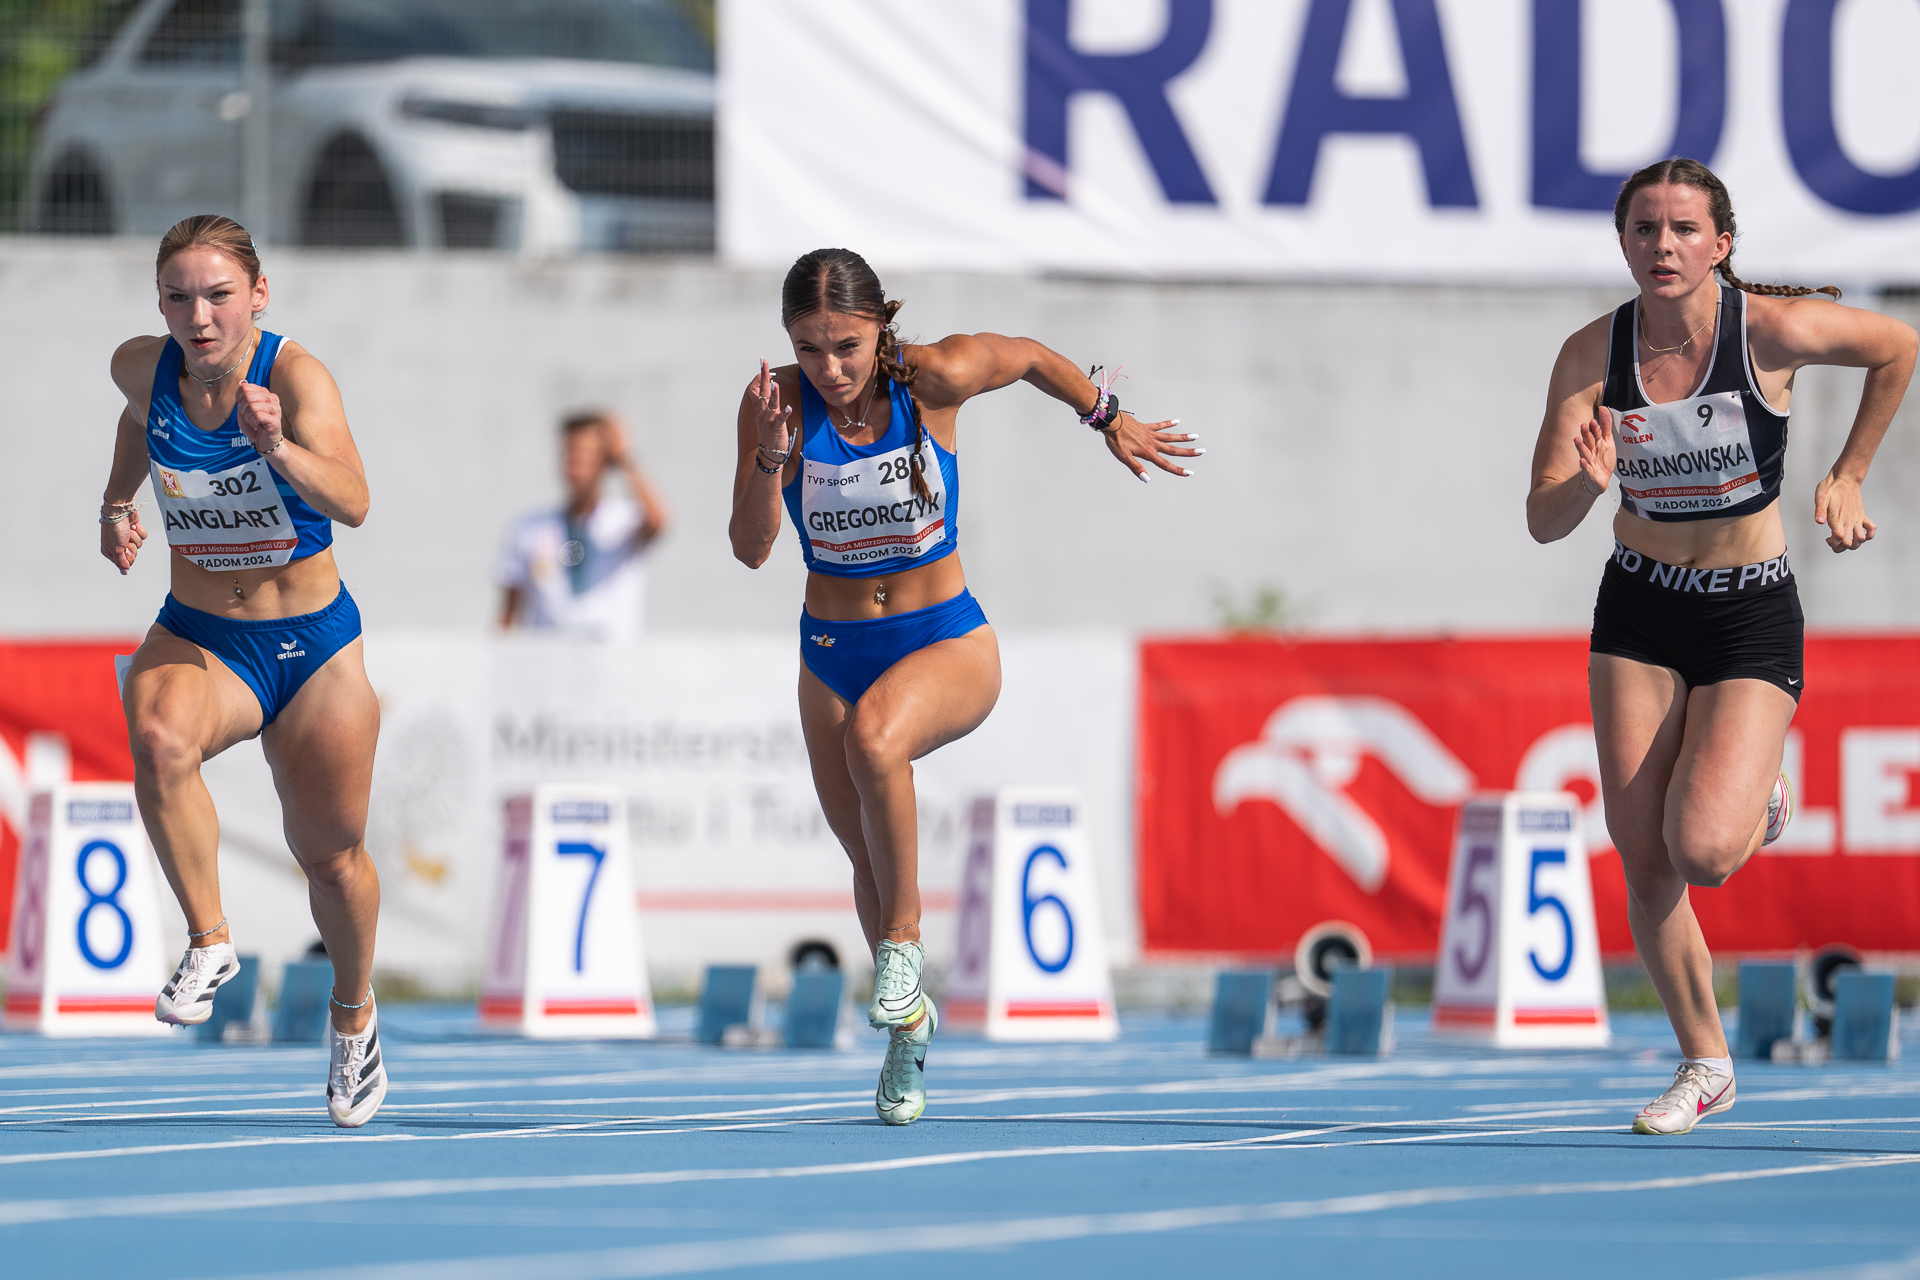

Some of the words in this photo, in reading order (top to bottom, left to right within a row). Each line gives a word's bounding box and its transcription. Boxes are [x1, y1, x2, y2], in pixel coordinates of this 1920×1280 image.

[1697, 404, 1714, 428] 9
[1622, 433, 1654, 445] ORLEN
[1616, 442, 1750, 480] BARANOWSKA
[208, 470, 262, 497] 302
[807, 475, 826, 486] TVP
[827, 474, 861, 487] SPORT
[1646, 488, 1663, 497] PZLA
[1664, 486, 1709, 496] Mistrzostwa
[1710, 483, 1732, 494] Polski
[1732, 478, 1747, 488] U20
[808, 491, 940, 533] GREGORCZYK
[1655, 499, 1700, 510] RADOM
[1702, 496, 1732, 508] 2024
[166, 504, 281, 532] ANGLART
[190, 544, 207, 553] PZLA
[208, 543, 250, 553] Mistrzostwa
[251, 542, 273, 551] Polski
[273, 541, 288, 549] U20
[834, 543, 852, 552] PZLA
[853, 537, 900, 548] Mistrzostwa
[901, 532, 923, 543] Polski
[922, 525, 934, 536] U20
[197, 558, 242, 569] RADOM
[243, 554, 273, 566] 2024
[842, 548, 890, 562] RADOM
[892, 545, 922, 555] 2024
[1649, 561, 1733, 593] NIKE
[1738, 550, 1790, 590] PRO
[77, 839, 133, 970] 8
[556, 842, 605, 975] 7
[1021, 843, 1075, 975] 6
[1453, 846, 1494, 983] 5
[1527, 848, 1575, 982] 5
